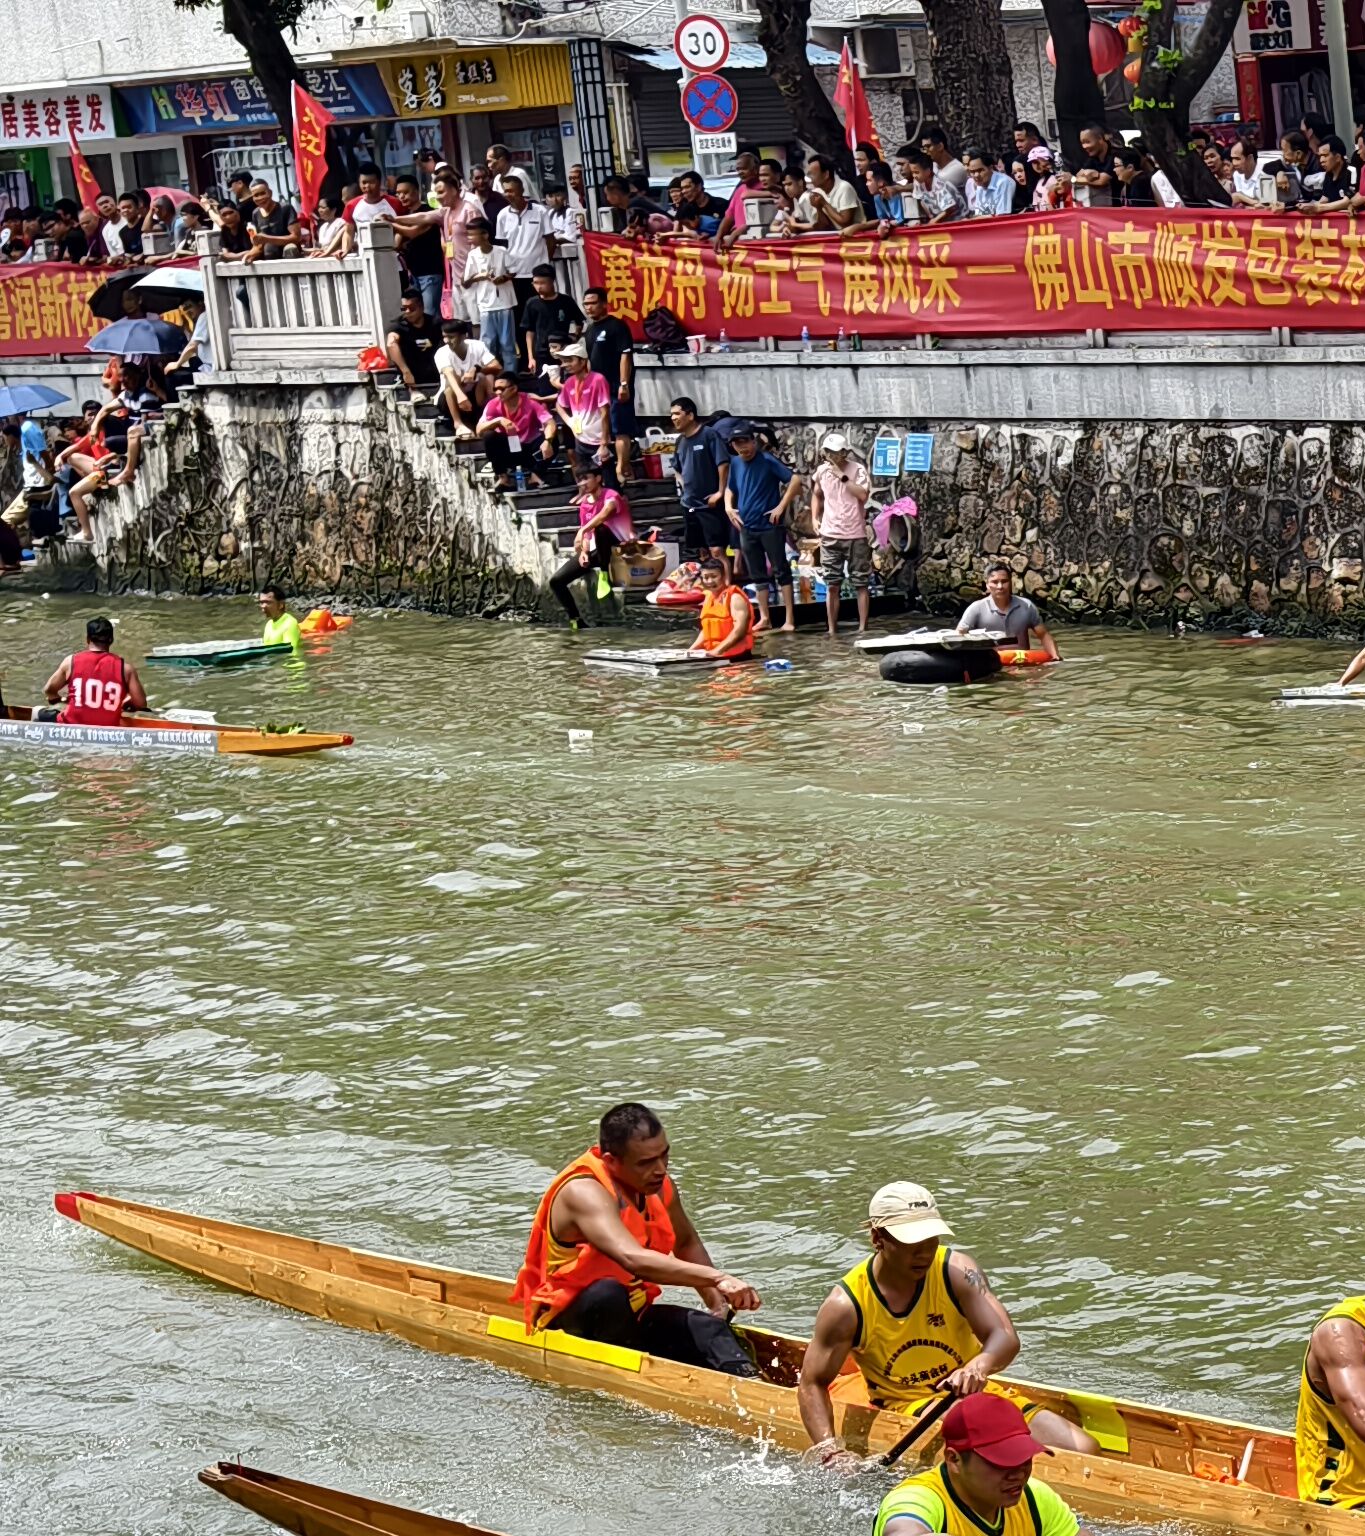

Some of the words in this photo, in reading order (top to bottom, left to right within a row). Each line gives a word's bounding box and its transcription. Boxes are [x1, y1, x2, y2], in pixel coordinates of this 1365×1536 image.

[687, 31, 717, 56] 30
[1, 94, 105, 140] 居美容美发
[175, 82, 239, 126] 华虹
[72, 677, 122, 712] 103
